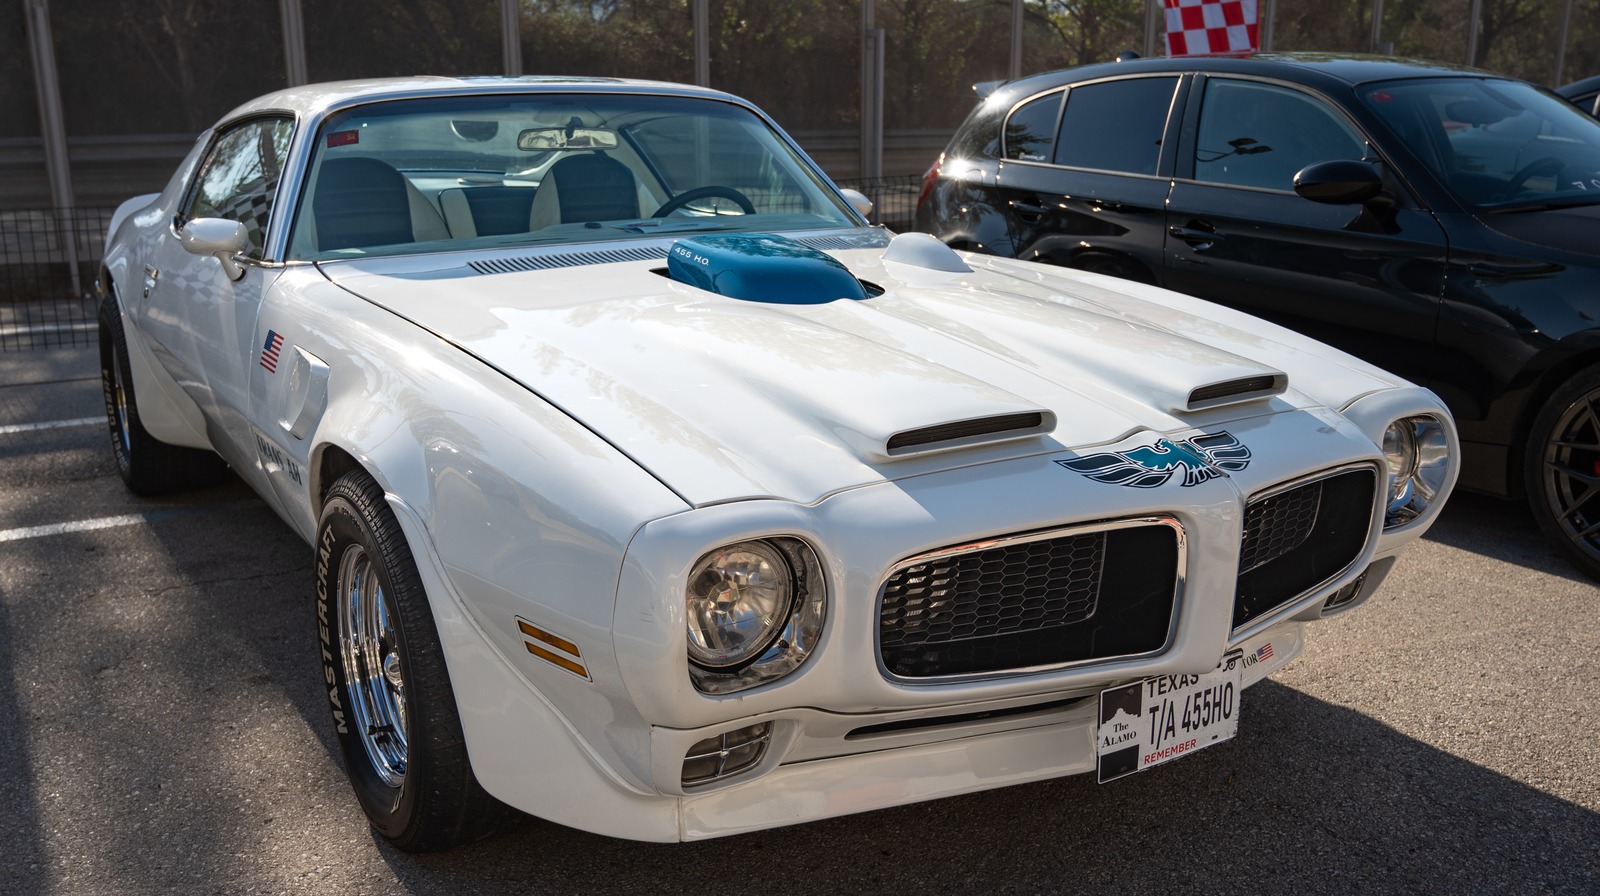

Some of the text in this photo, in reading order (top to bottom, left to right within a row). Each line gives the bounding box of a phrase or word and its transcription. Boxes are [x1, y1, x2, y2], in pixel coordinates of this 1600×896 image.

[674, 247, 692, 258] 455
[254, 432, 303, 486] TRANS AM
[316, 524, 349, 735] MASTERCRAFT
[1147, 673, 1199, 698] TEXAS
[1112, 722, 1129, 733] The
[1149, 681, 1234, 750] T/A 455HO
[1101, 731, 1137, 748] ALAMO
[1143, 739, 1197, 765] REMEMBER
